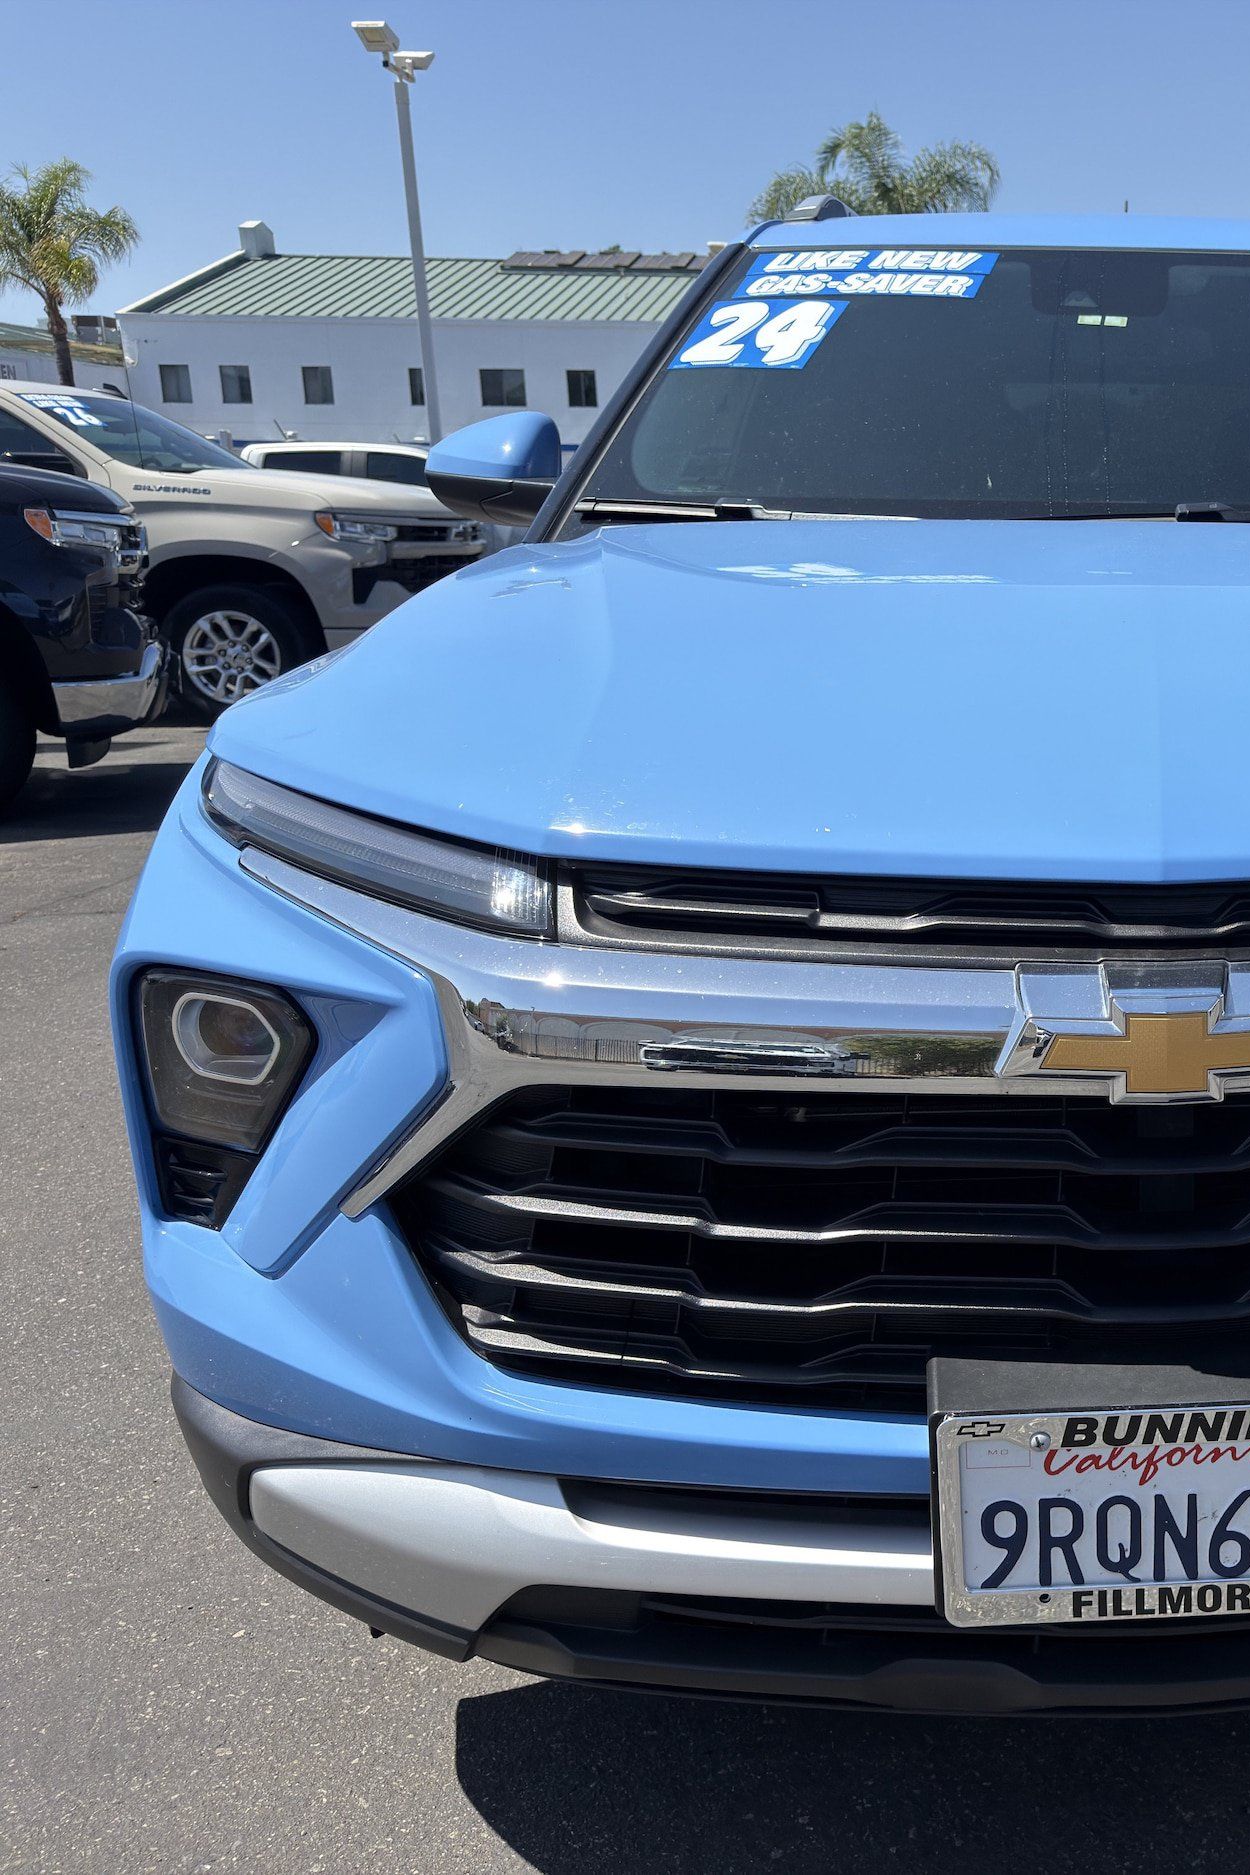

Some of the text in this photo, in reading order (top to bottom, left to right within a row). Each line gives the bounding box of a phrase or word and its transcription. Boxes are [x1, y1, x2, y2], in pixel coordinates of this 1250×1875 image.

[763, 250, 984, 272] LIKE NEW
[745, 273, 973, 297] GAS-SAVER
[680, 301, 836, 366] 24
[132, 484, 212, 495] SILVERADO
